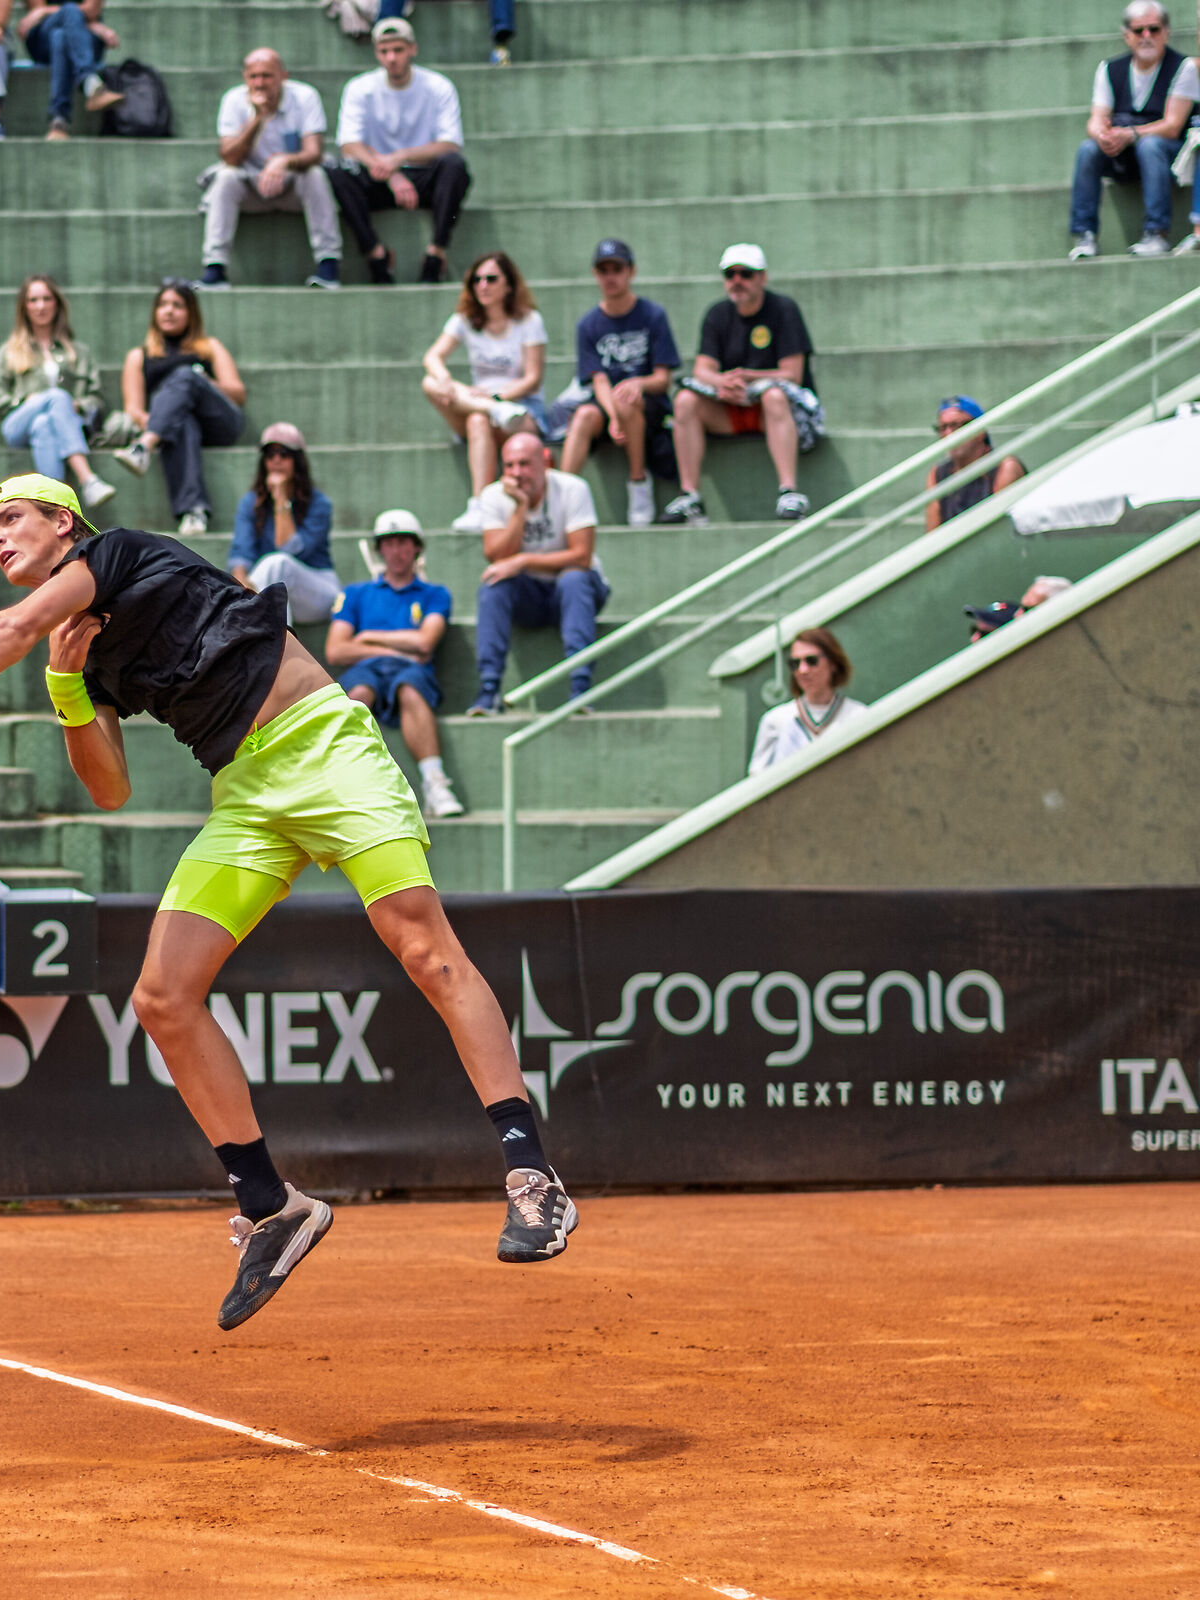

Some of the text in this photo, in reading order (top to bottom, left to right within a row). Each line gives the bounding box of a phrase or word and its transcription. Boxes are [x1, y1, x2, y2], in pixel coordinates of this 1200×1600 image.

[31, 919, 70, 977] 2
[657, 1079, 1006, 1109] YOUR NEXT ENERGY
[1130, 1129, 1200, 1152] SUPER
